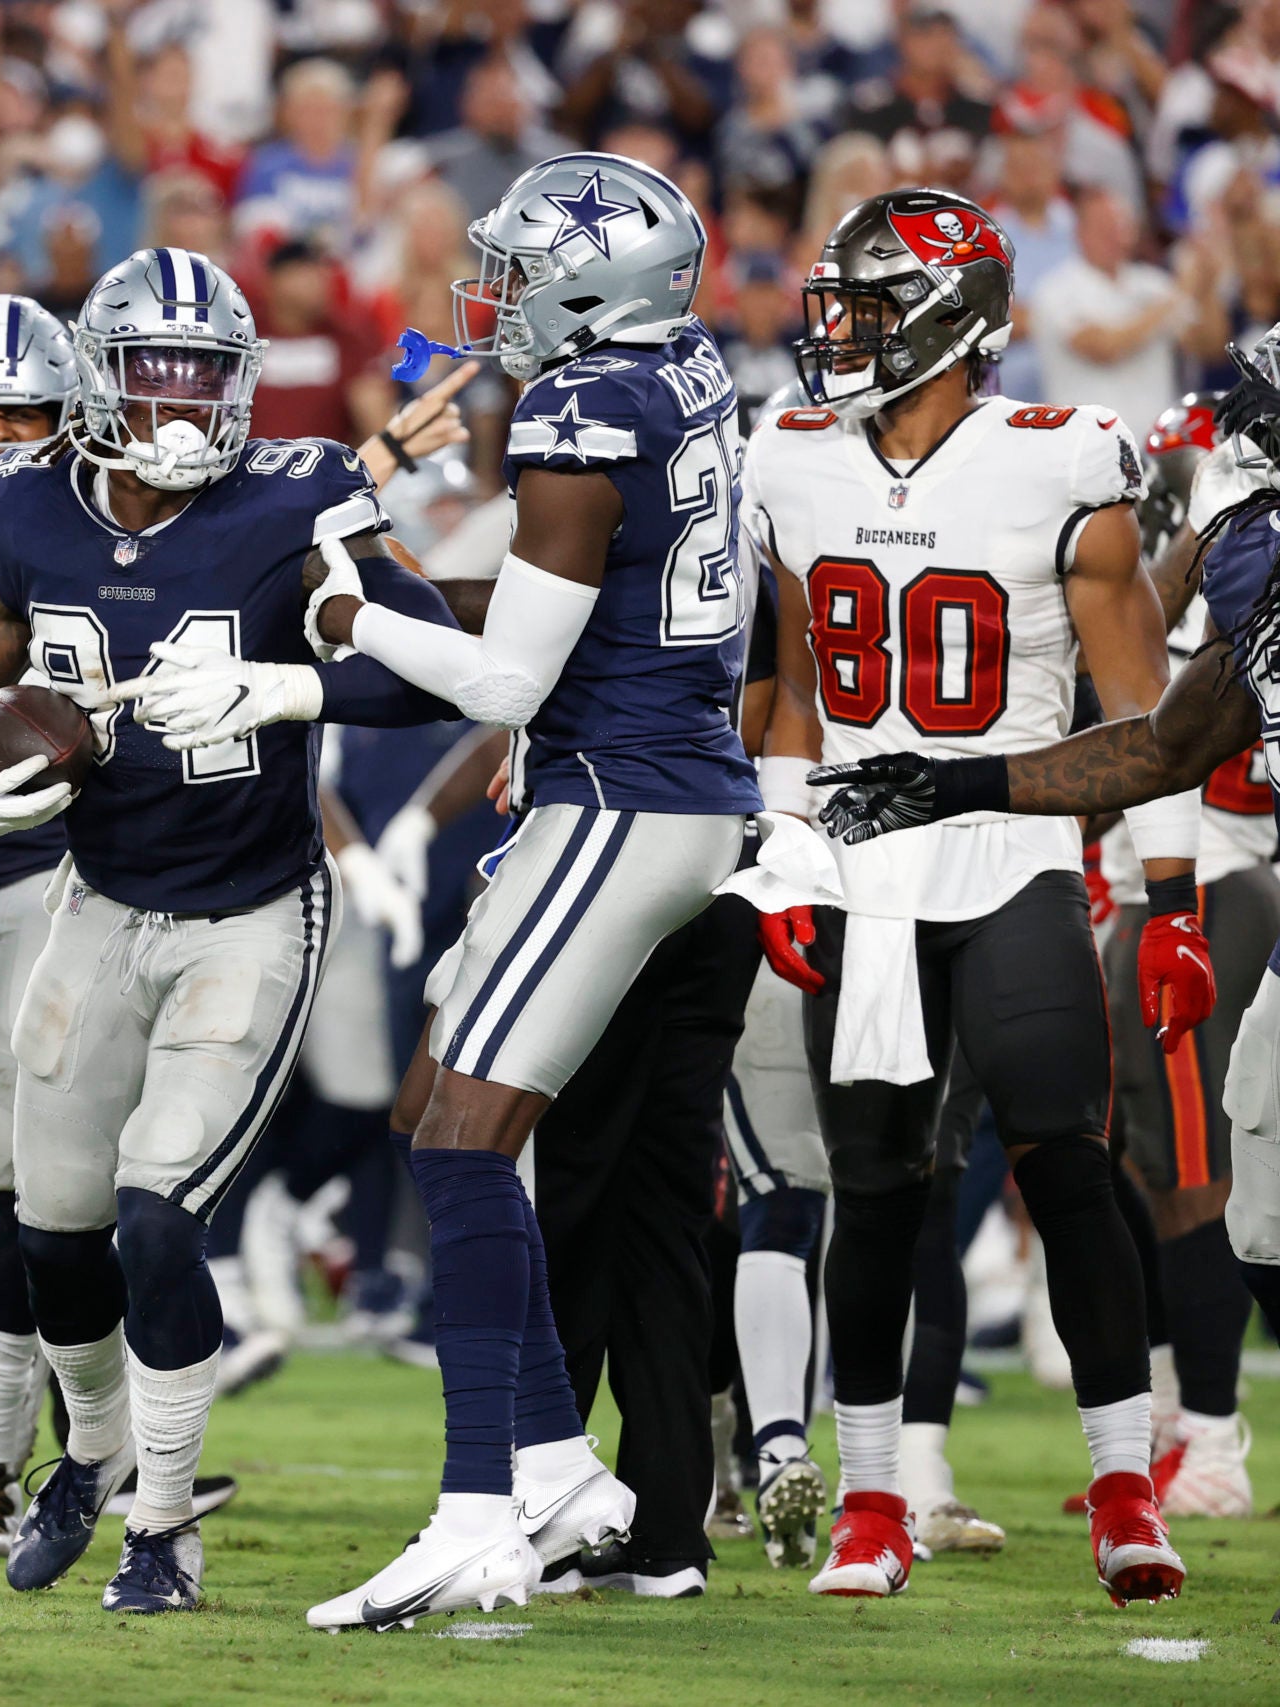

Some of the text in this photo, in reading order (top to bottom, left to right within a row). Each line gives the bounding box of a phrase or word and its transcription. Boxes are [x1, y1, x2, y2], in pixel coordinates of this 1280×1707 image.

[855, 526, 937, 550] BUCCANEERS
[98, 586, 156, 601] COWBOYS
[807, 555, 1011, 737] 80
